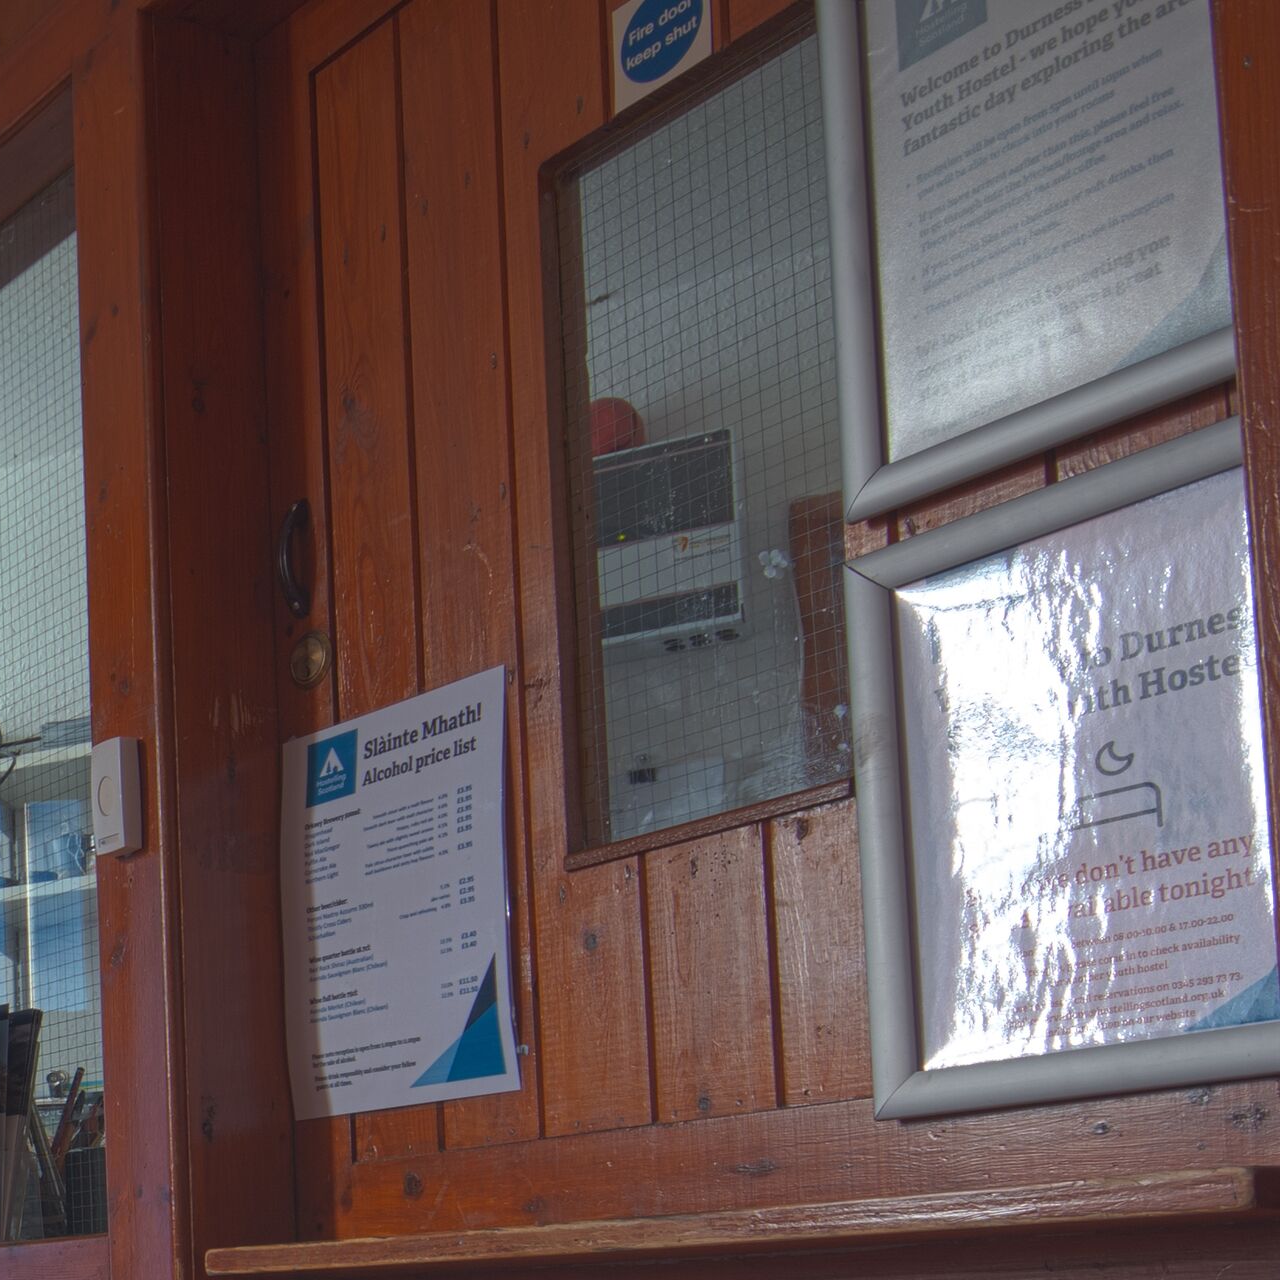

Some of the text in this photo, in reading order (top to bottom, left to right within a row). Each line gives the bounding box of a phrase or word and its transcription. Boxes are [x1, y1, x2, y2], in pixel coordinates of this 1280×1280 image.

[627, 16, 697, 71] keep shut
[628, 0, 692, 46] Fire door
[900, 0, 1083, 108] Welcome to Durness
[901, 0, 1138, 132] Youth Hostel we hope yo
[902, 11, 1151, 157] fantastic day exploring the
[1119, 605, 1243, 662] Durnes
[1138, 653, 1241, 700] Hoste
[363, 702, 482, 760] Slàinte Mhath!
[362, 736, 477, 787] Alcohol price list
[1075, 834, 1255, 886] don't have any
[1158, 866, 1256, 900] tonight
[1137, 960, 1169, 974] hostel
[1138, 933, 1241, 958] to check availability
[1157, 982, 1170, 991] on
[1197, 975, 1214, 986] 293
[1215, 972, 1228, 983] 73
[1156, 1007, 1197, 1021] website
